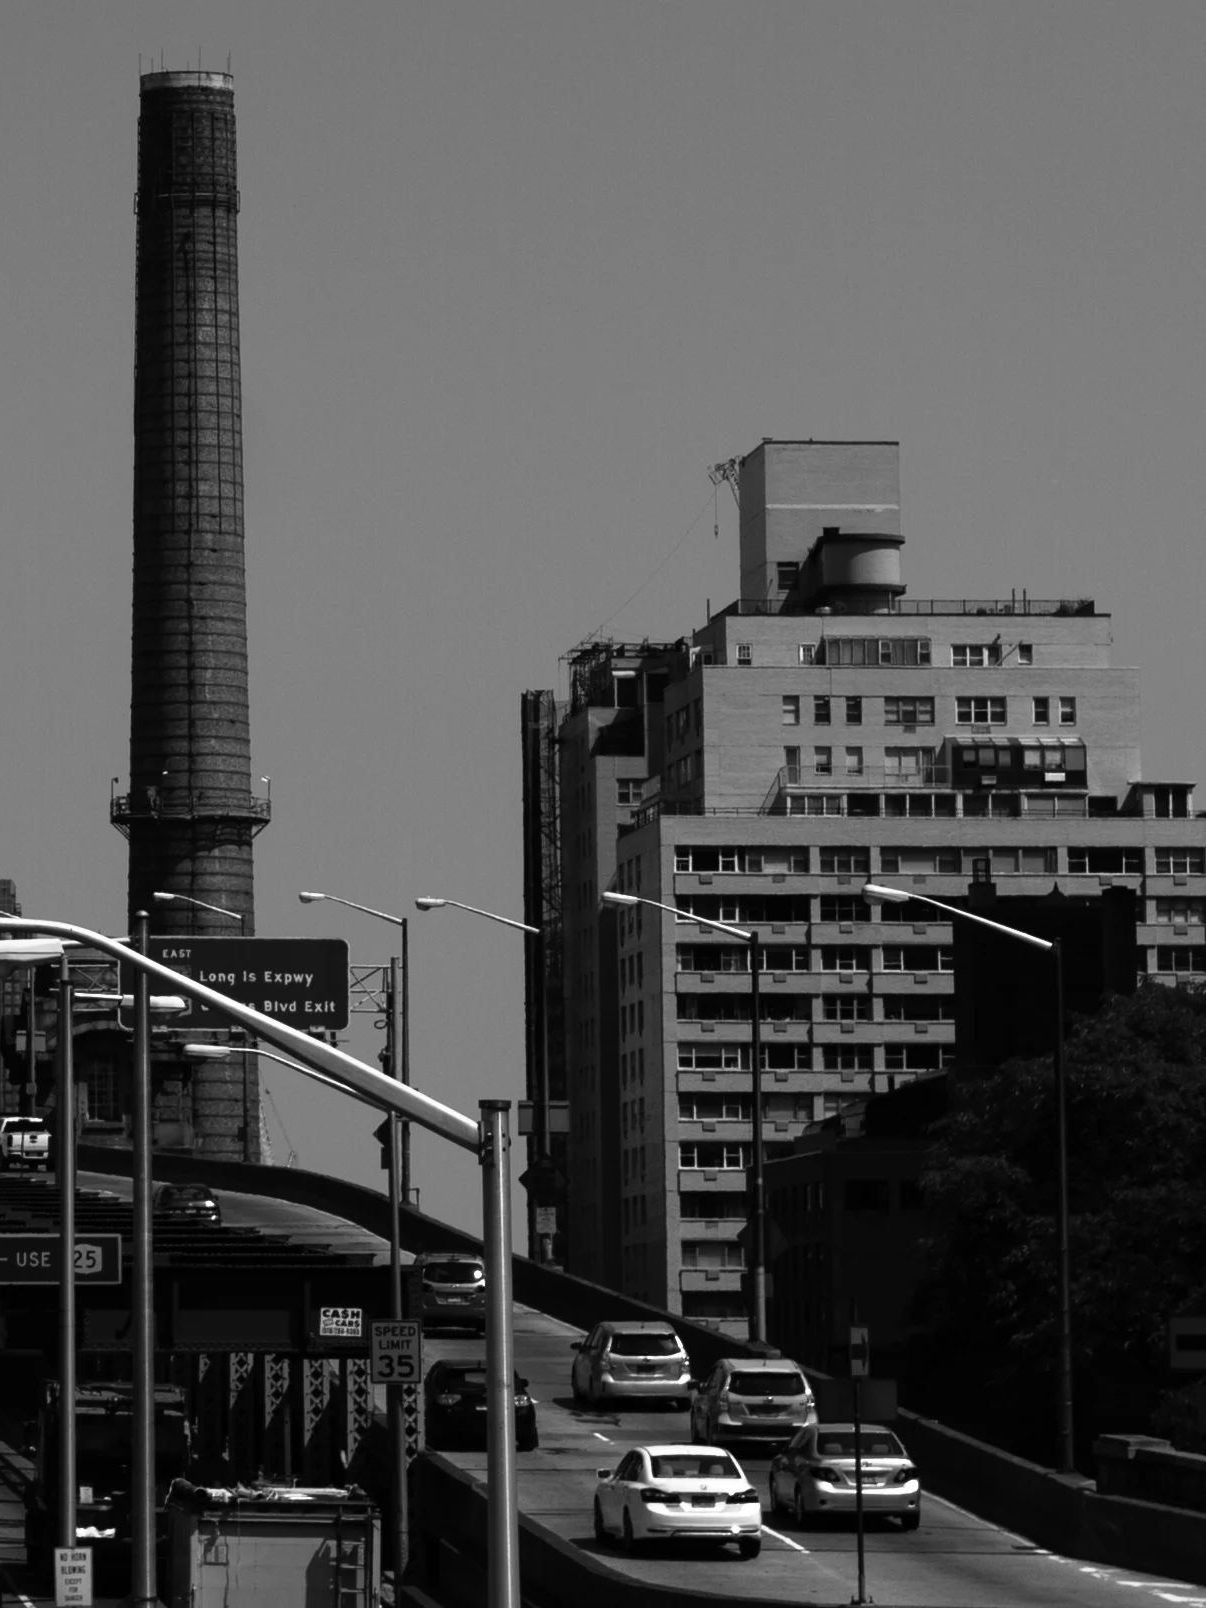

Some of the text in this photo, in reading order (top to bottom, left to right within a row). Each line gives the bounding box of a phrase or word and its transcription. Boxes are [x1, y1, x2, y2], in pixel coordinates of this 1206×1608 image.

[162, 949, 192, 959] EAST
[199, 970, 314, 988] Long Is Expwy
[263, 1000, 297, 1012] Blvd
[304, 1000, 336, 1012] Exit
[16, 1252, 51, 1268] USE
[73, 1250, 96, 1269] 25
[375, 1326, 416, 1337] SPEED
[378, 1339, 412, 1350] LIMIT
[378, 1355, 415, 1378] 35
[60, 1552, 68, 1561] NO
